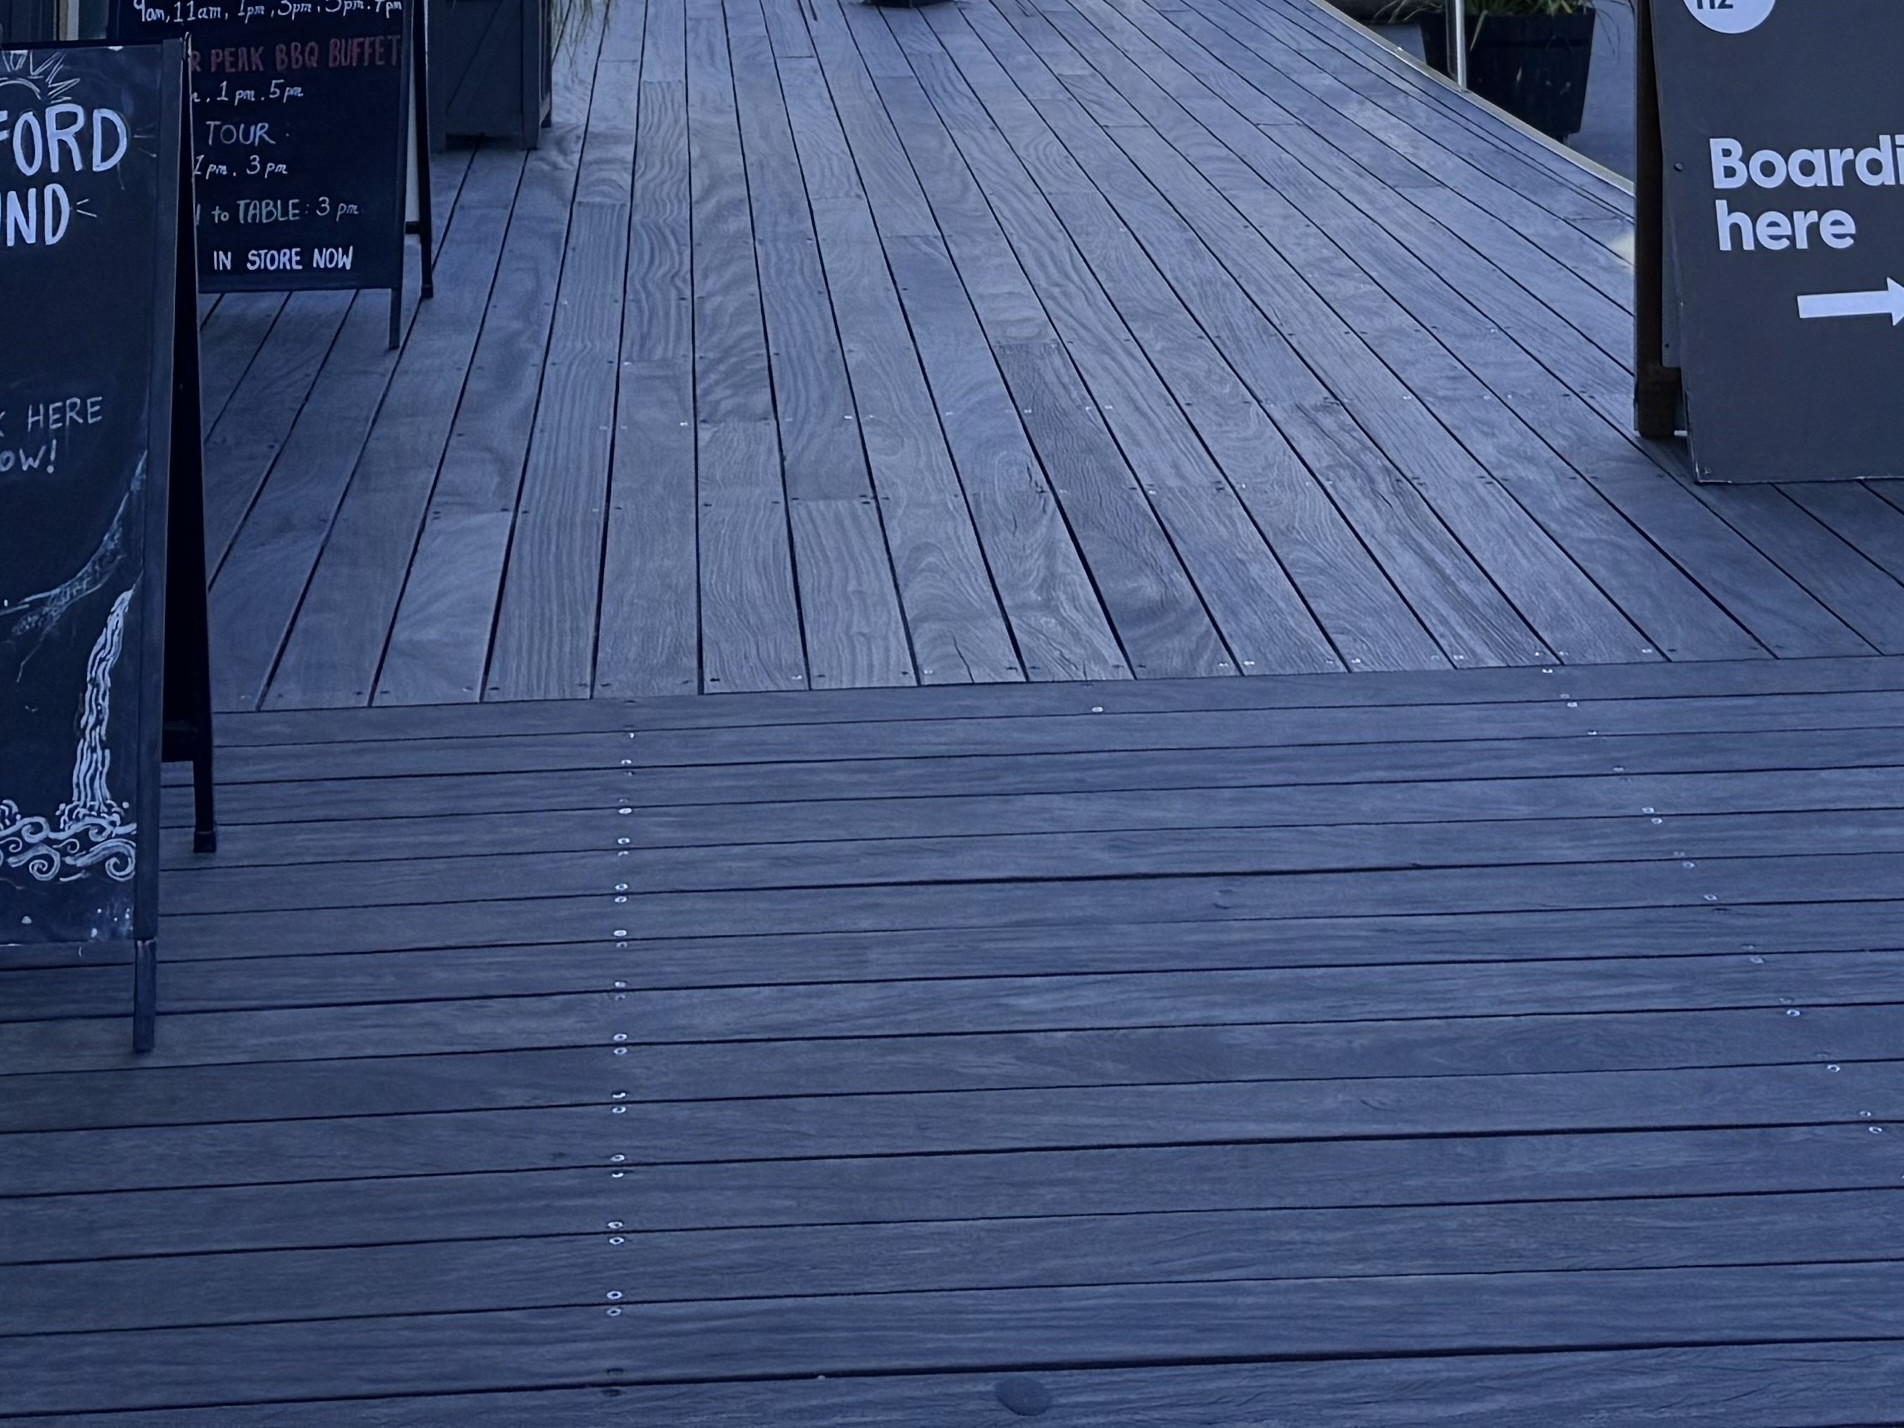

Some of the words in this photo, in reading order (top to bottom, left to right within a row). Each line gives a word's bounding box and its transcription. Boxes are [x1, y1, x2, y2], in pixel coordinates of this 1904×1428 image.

[210, 45, 265, 73] PEAK
[275, 41, 320, 72] BBQ
[328, 34, 401, 69] BUFFET
[211, 206, 230, 223] to
[1714, 199, 1857, 252] here
[213, 250, 232, 271] IN
[246, 247, 303, 271] STORE
[312, 245, 354, 271] NOW
[27, 396, 103, 433] HERE
